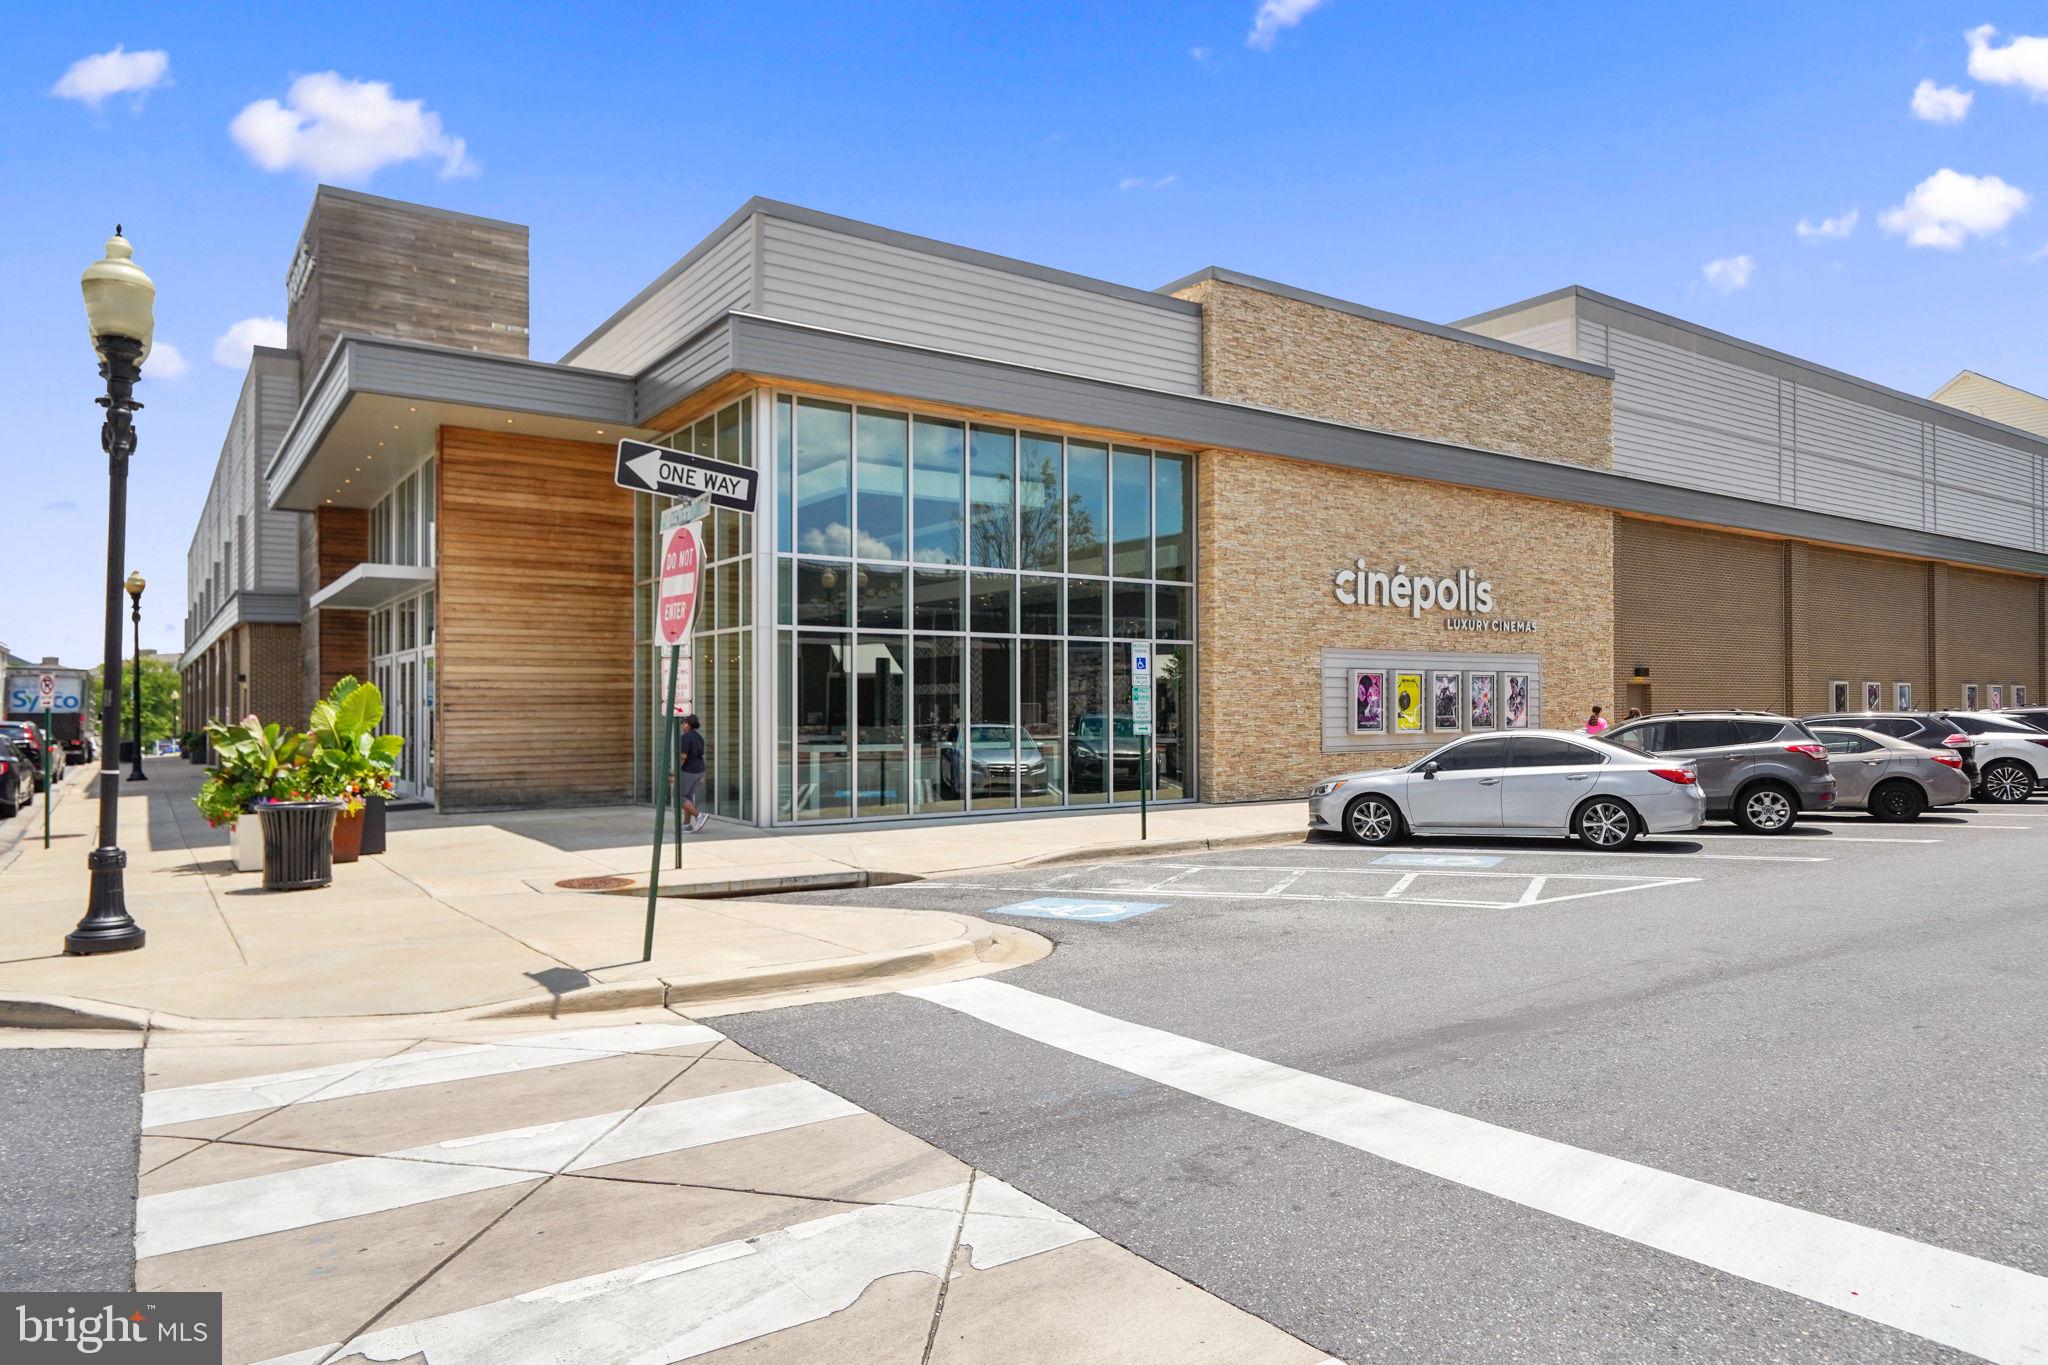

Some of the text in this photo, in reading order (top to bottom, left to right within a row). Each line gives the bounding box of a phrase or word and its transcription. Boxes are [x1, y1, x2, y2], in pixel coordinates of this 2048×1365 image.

[659, 463, 741, 496] ONE WAY
[666, 548, 694, 570] DO NOT
[1335, 558, 1493, 619] cinépolis
[664, 601, 686, 621] ENTER
[1446, 618, 1538, 633] LUXURY CINEMAS
[12, 689, 79, 712] Syco
